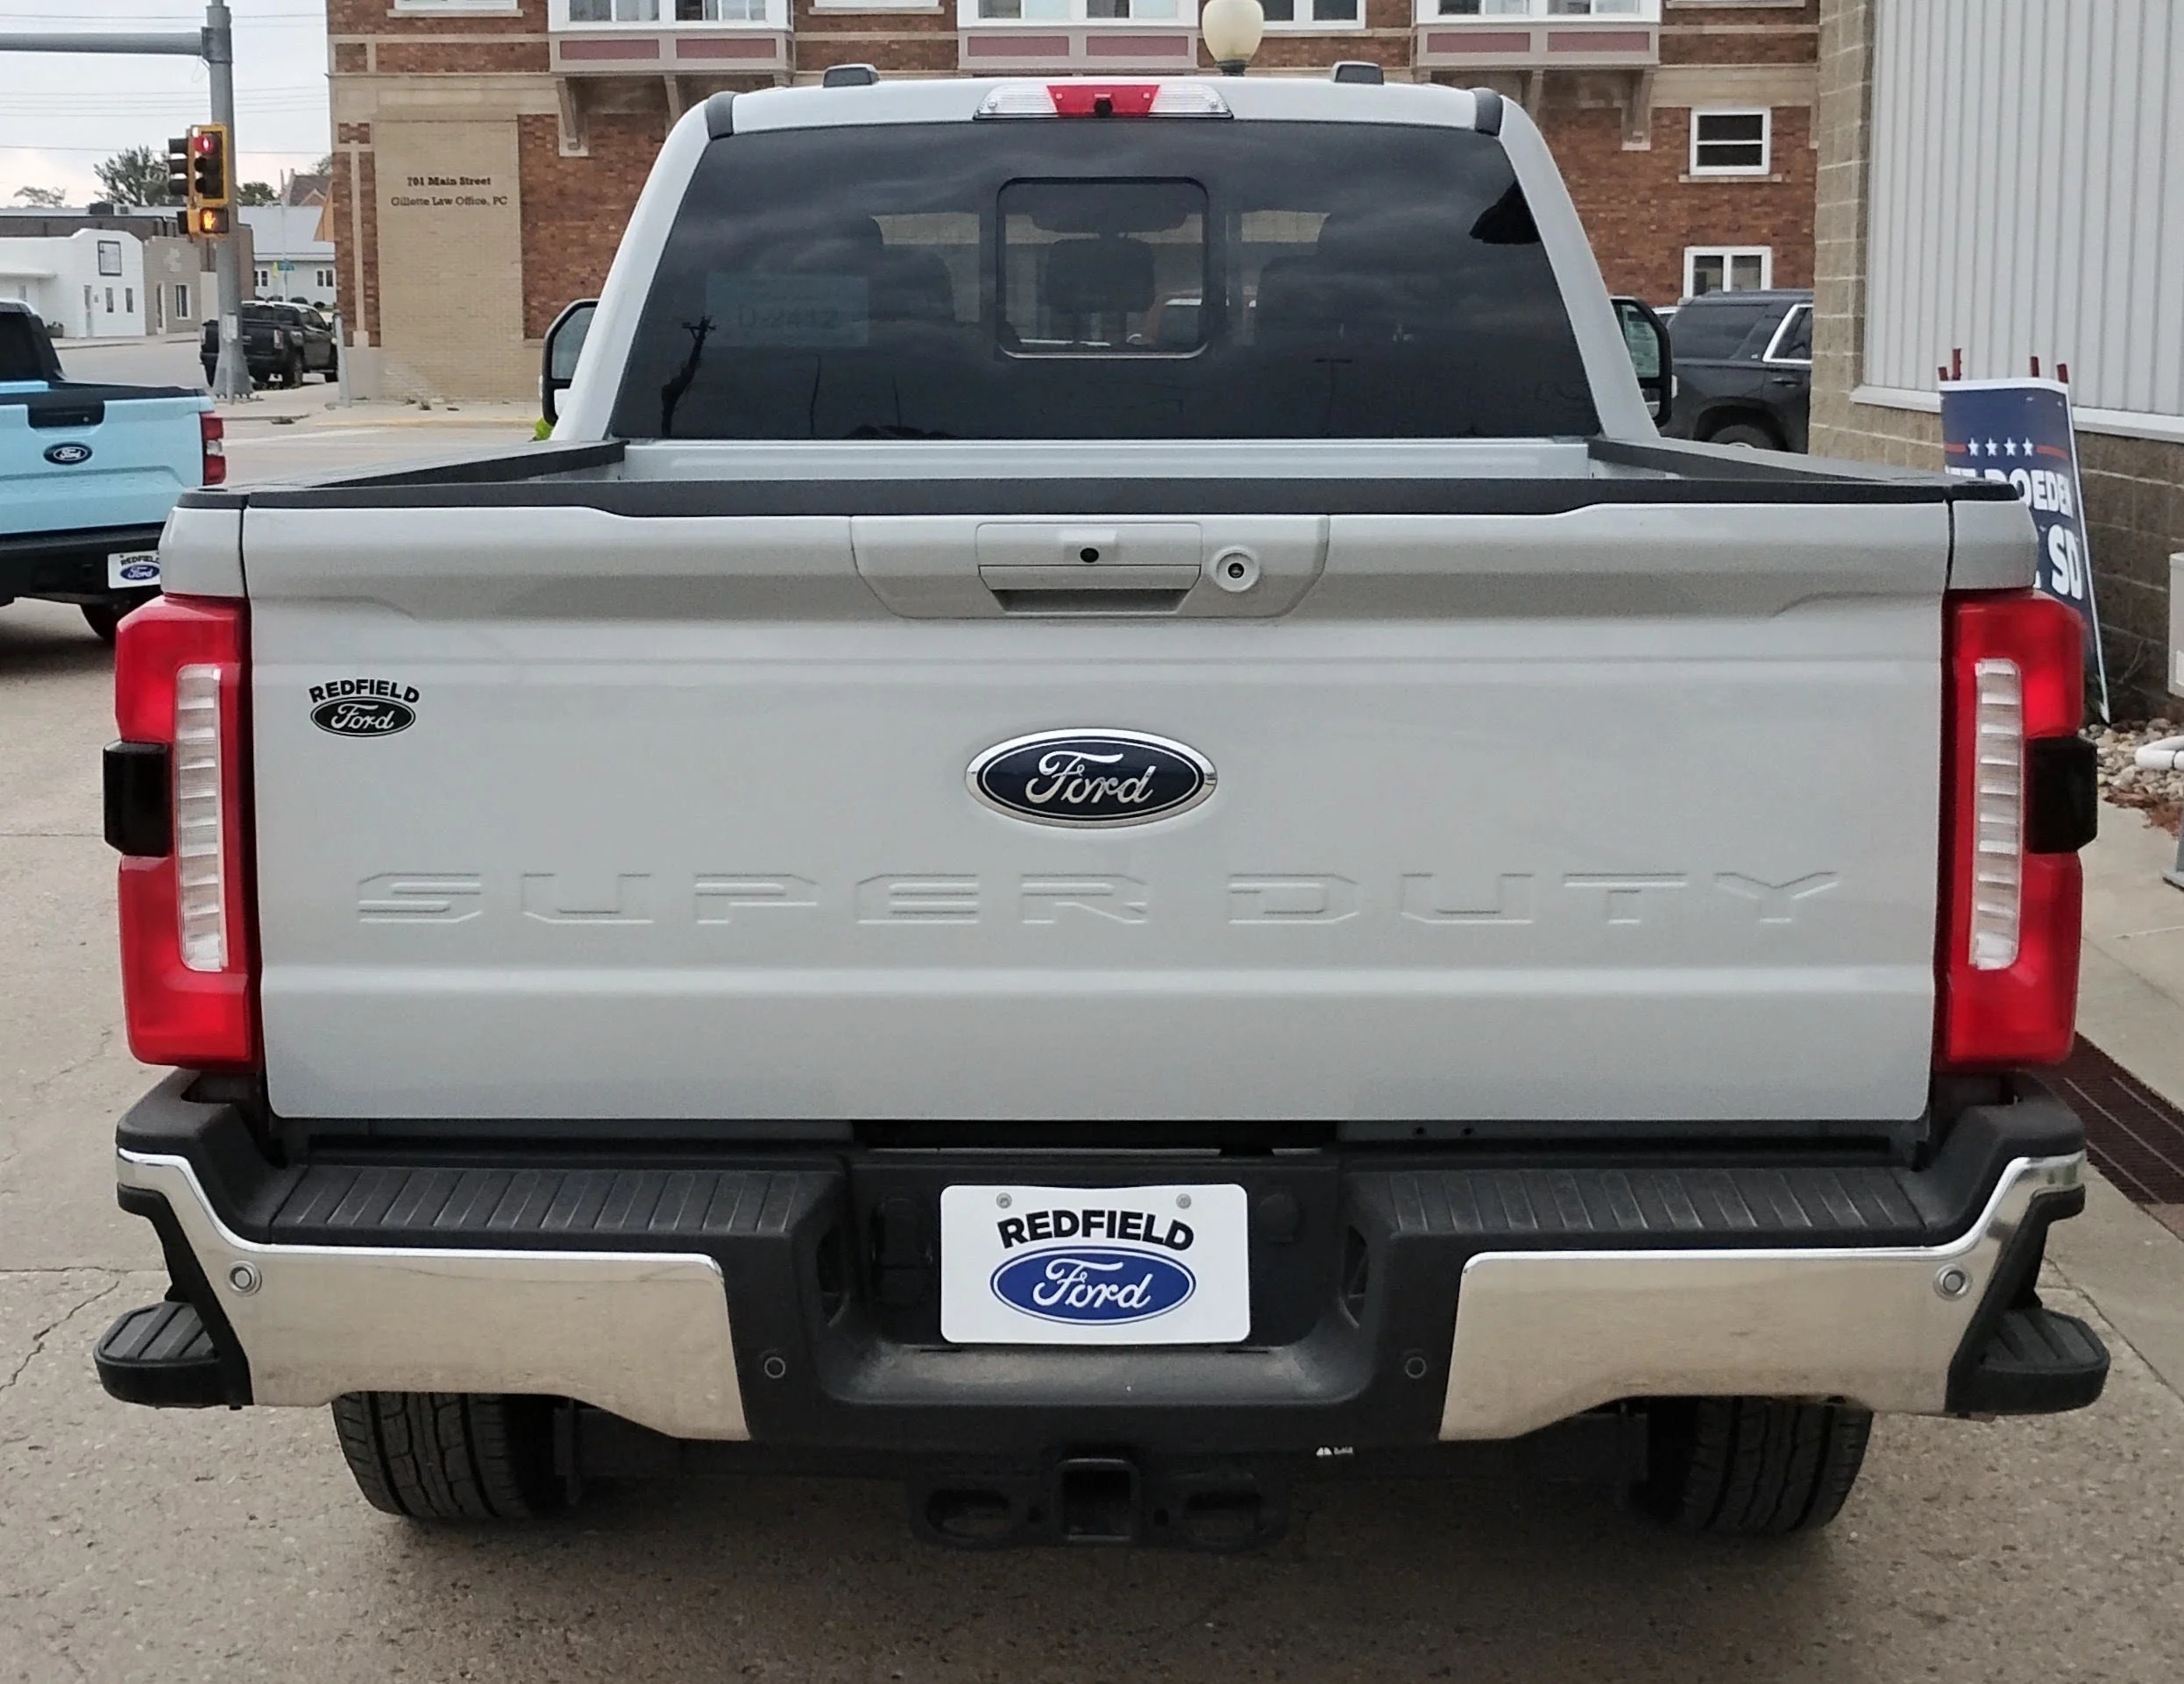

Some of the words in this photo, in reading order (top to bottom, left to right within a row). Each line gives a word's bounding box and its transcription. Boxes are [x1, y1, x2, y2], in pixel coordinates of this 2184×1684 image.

[428, 177, 457, 186] Main
[459, 177, 491, 186] Street
[391, 196, 429, 206] Gillette
[432, 196, 452, 206] Law
[493, 196, 507, 205] PC
[127, 566, 153, 579] Ford
[2047, 523, 2083, 600] SD
[308, 679, 420, 703] REDFIELD
[330, 703, 395, 729] Ford
[1025, 750, 1157, 804] Ford
[358, 872, 1148, 925] SUPER
[1229, 871, 1839, 925] DUTY
[996, 1209, 1195, 1251] REDFIELD
[1032, 1257, 1153, 1309] Ford
